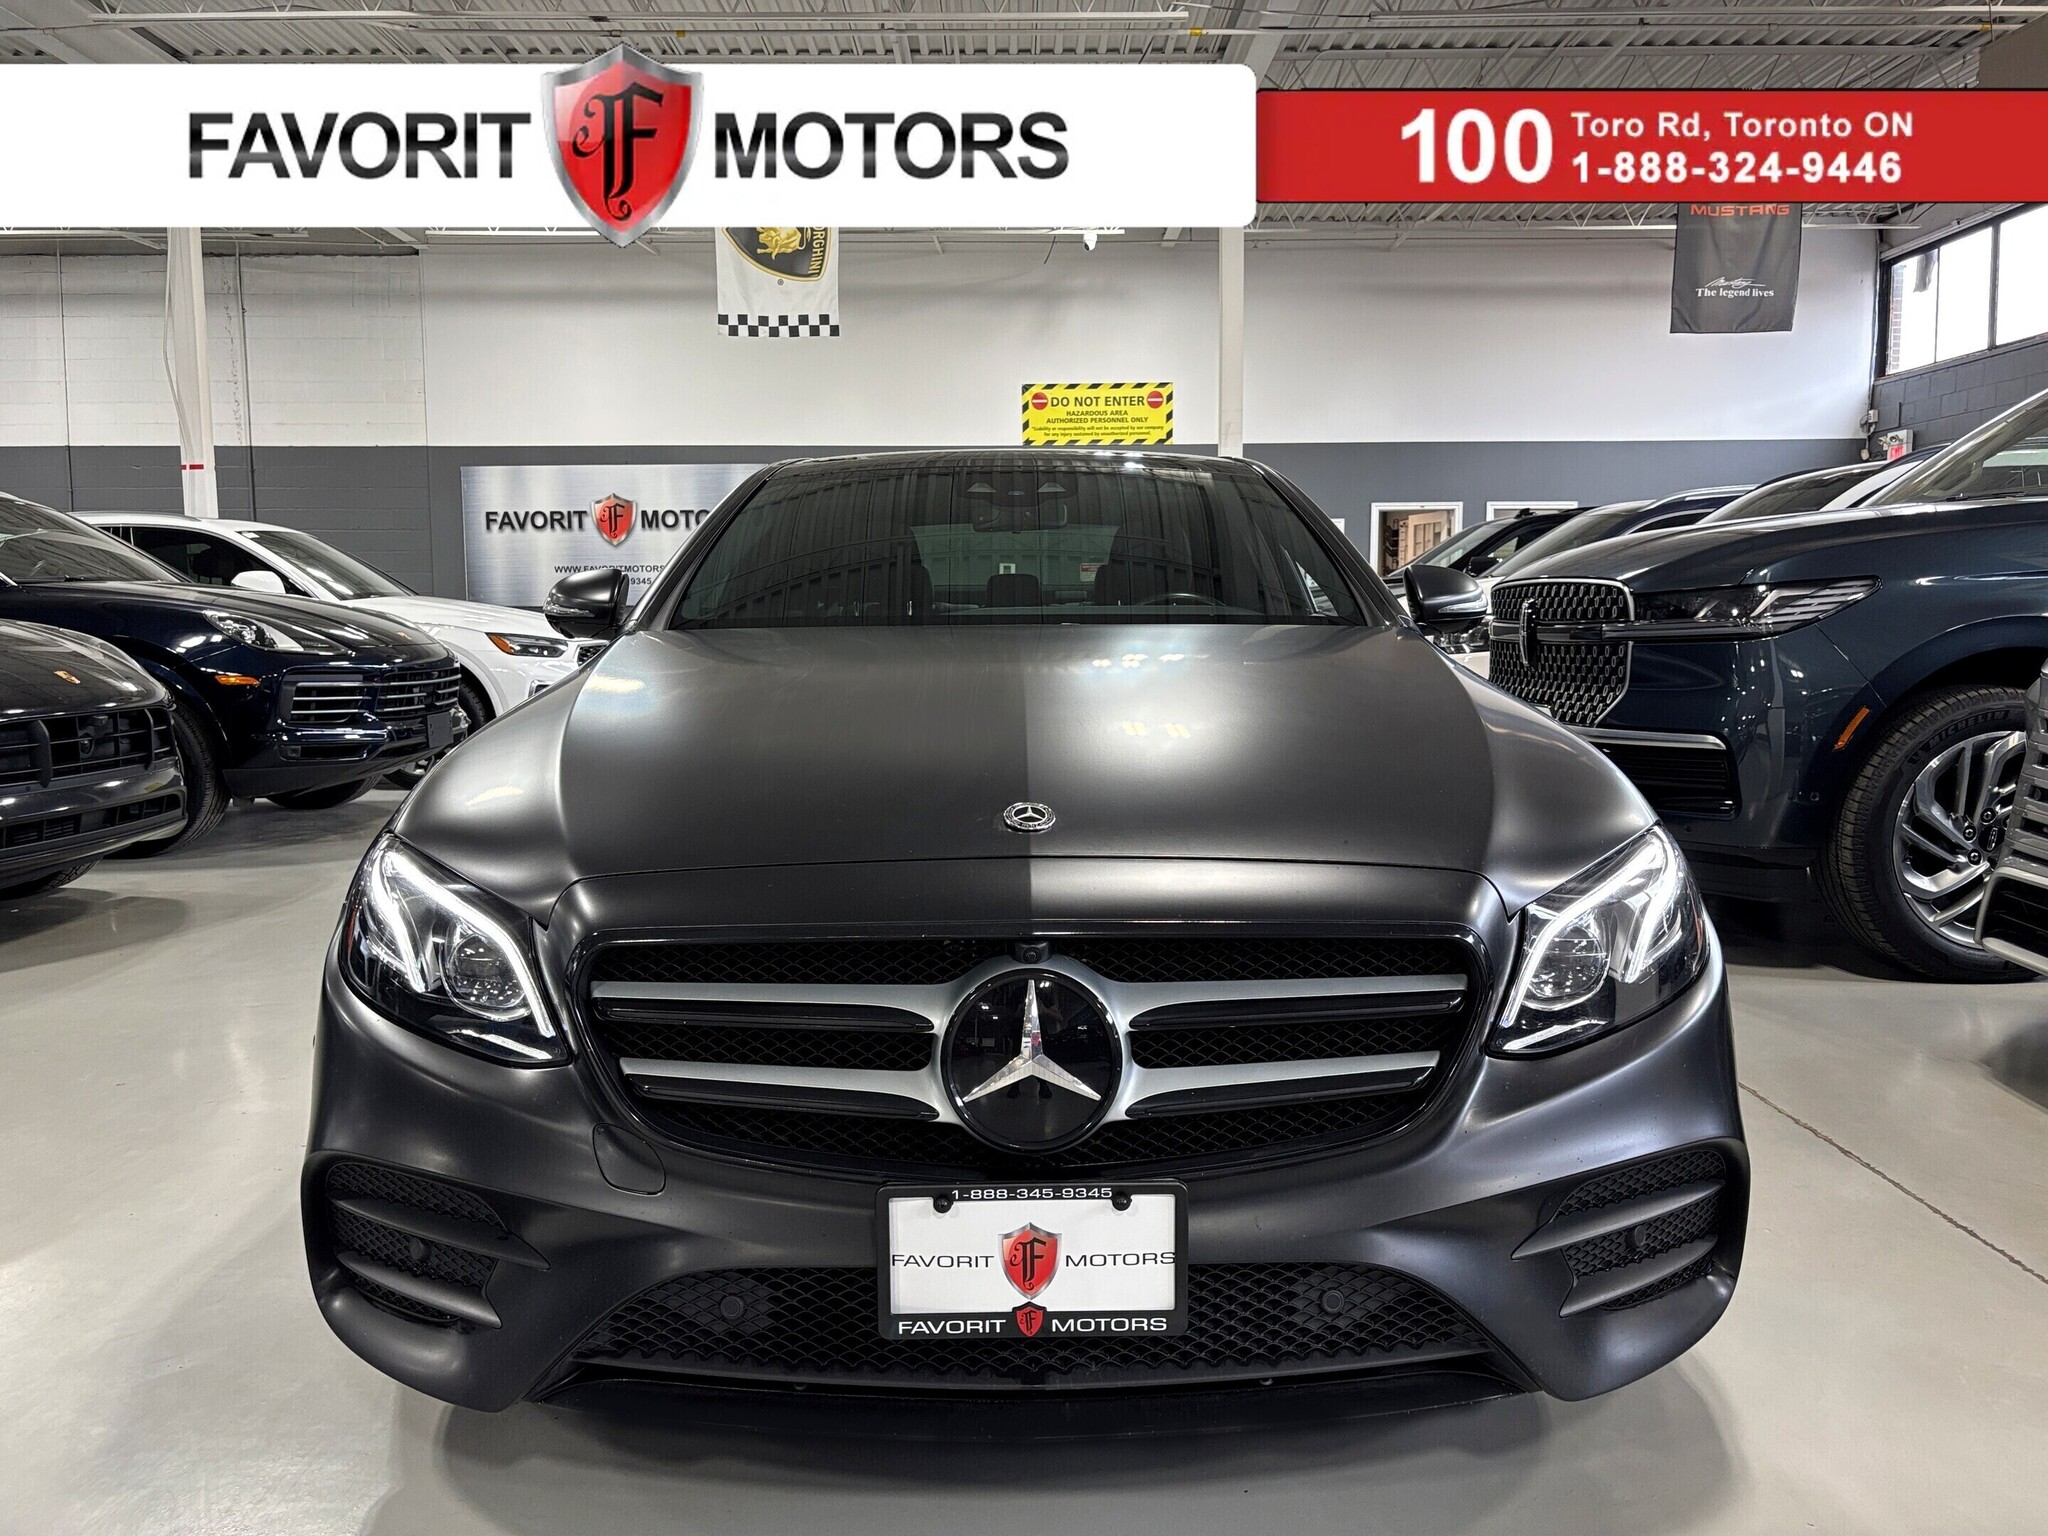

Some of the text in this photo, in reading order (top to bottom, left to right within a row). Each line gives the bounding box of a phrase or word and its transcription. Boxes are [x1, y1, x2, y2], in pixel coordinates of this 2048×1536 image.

[1691, 203, 1790, 217] MUSTANG
[1696, 288, 1775, 298] The legend lives
[1051, 396, 1145, 407] DO NOT ENTER
[485, 510, 588, 530] FAVORIT
[1928, 710, 2006, 749] MICHELIN
[951, 1187, 1113, 1200] 1-888-345-9345
[891, 1254, 995, 1268] FAVORIT
[1065, 1251, 1176, 1267] MOTORS
[898, 1319, 1007, 1335] FAVORIT
[1052, 1317, 1167, 1332] MOTORS
